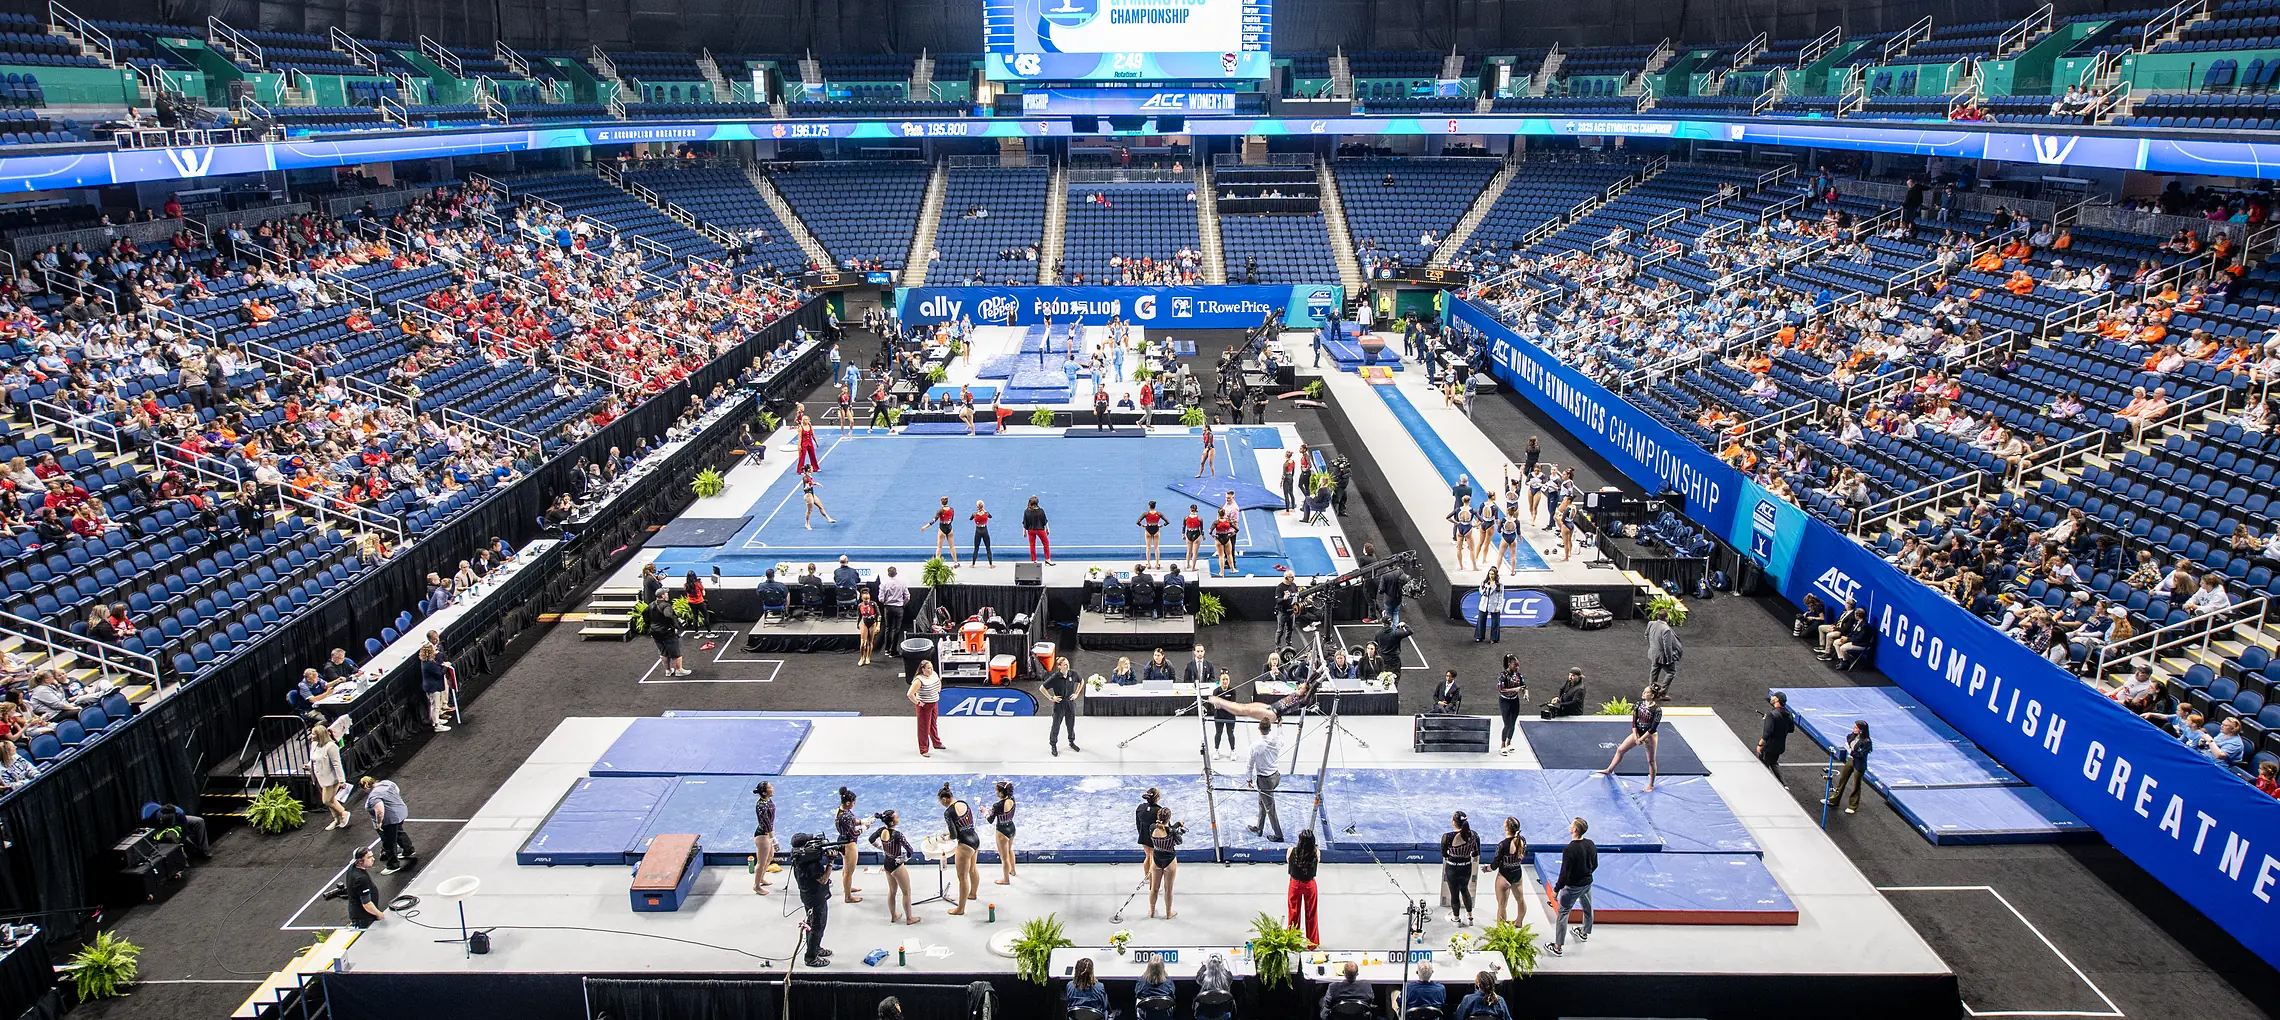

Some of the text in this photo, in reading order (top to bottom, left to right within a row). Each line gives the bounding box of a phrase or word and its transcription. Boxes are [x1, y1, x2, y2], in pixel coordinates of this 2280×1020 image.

[1110, 8, 1190, 24] CHAMPIONSHIP
[1114, 53, 1143, 69] 2:49
[1142, 93, 1184, 109] ACC
[1188, 93, 1222, 110] WOMEN'S
[614, 130, 652, 141] ACCOMPLISH
[655, 128, 696, 139] GREATNESS
[1310, 120, 1327, 133] Cal
[1577, 123, 1593, 133] 2025
[1593, 123, 1605, 133] ACC
[1605, 123, 1639, 134] GYMNASTICS
[1312, 290, 1330, 298] ACC
[919, 295, 962, 321] ally
[992, 296, 1006, 309] Dr
[1134, 295, 1157, 320] G
[1241, 301, 1270, 314] Price
[981, 301, 1016, 321] Pepper
[1491, 338, 1720, 513] ACC WOMEN'S GYMNASTICS CHAMPIONSHIP
[1757, 501, 1776, 518] ACC
[1500, 598, 1543, 615] CC
[946, 697, 1021, 716] ACC
[1816, 566, 2280, 904] ACC ACCOMPLISH GREATNE
[1135, 951, 1178, 963] 0000
[1389, 951, 1432, 963] 00000
